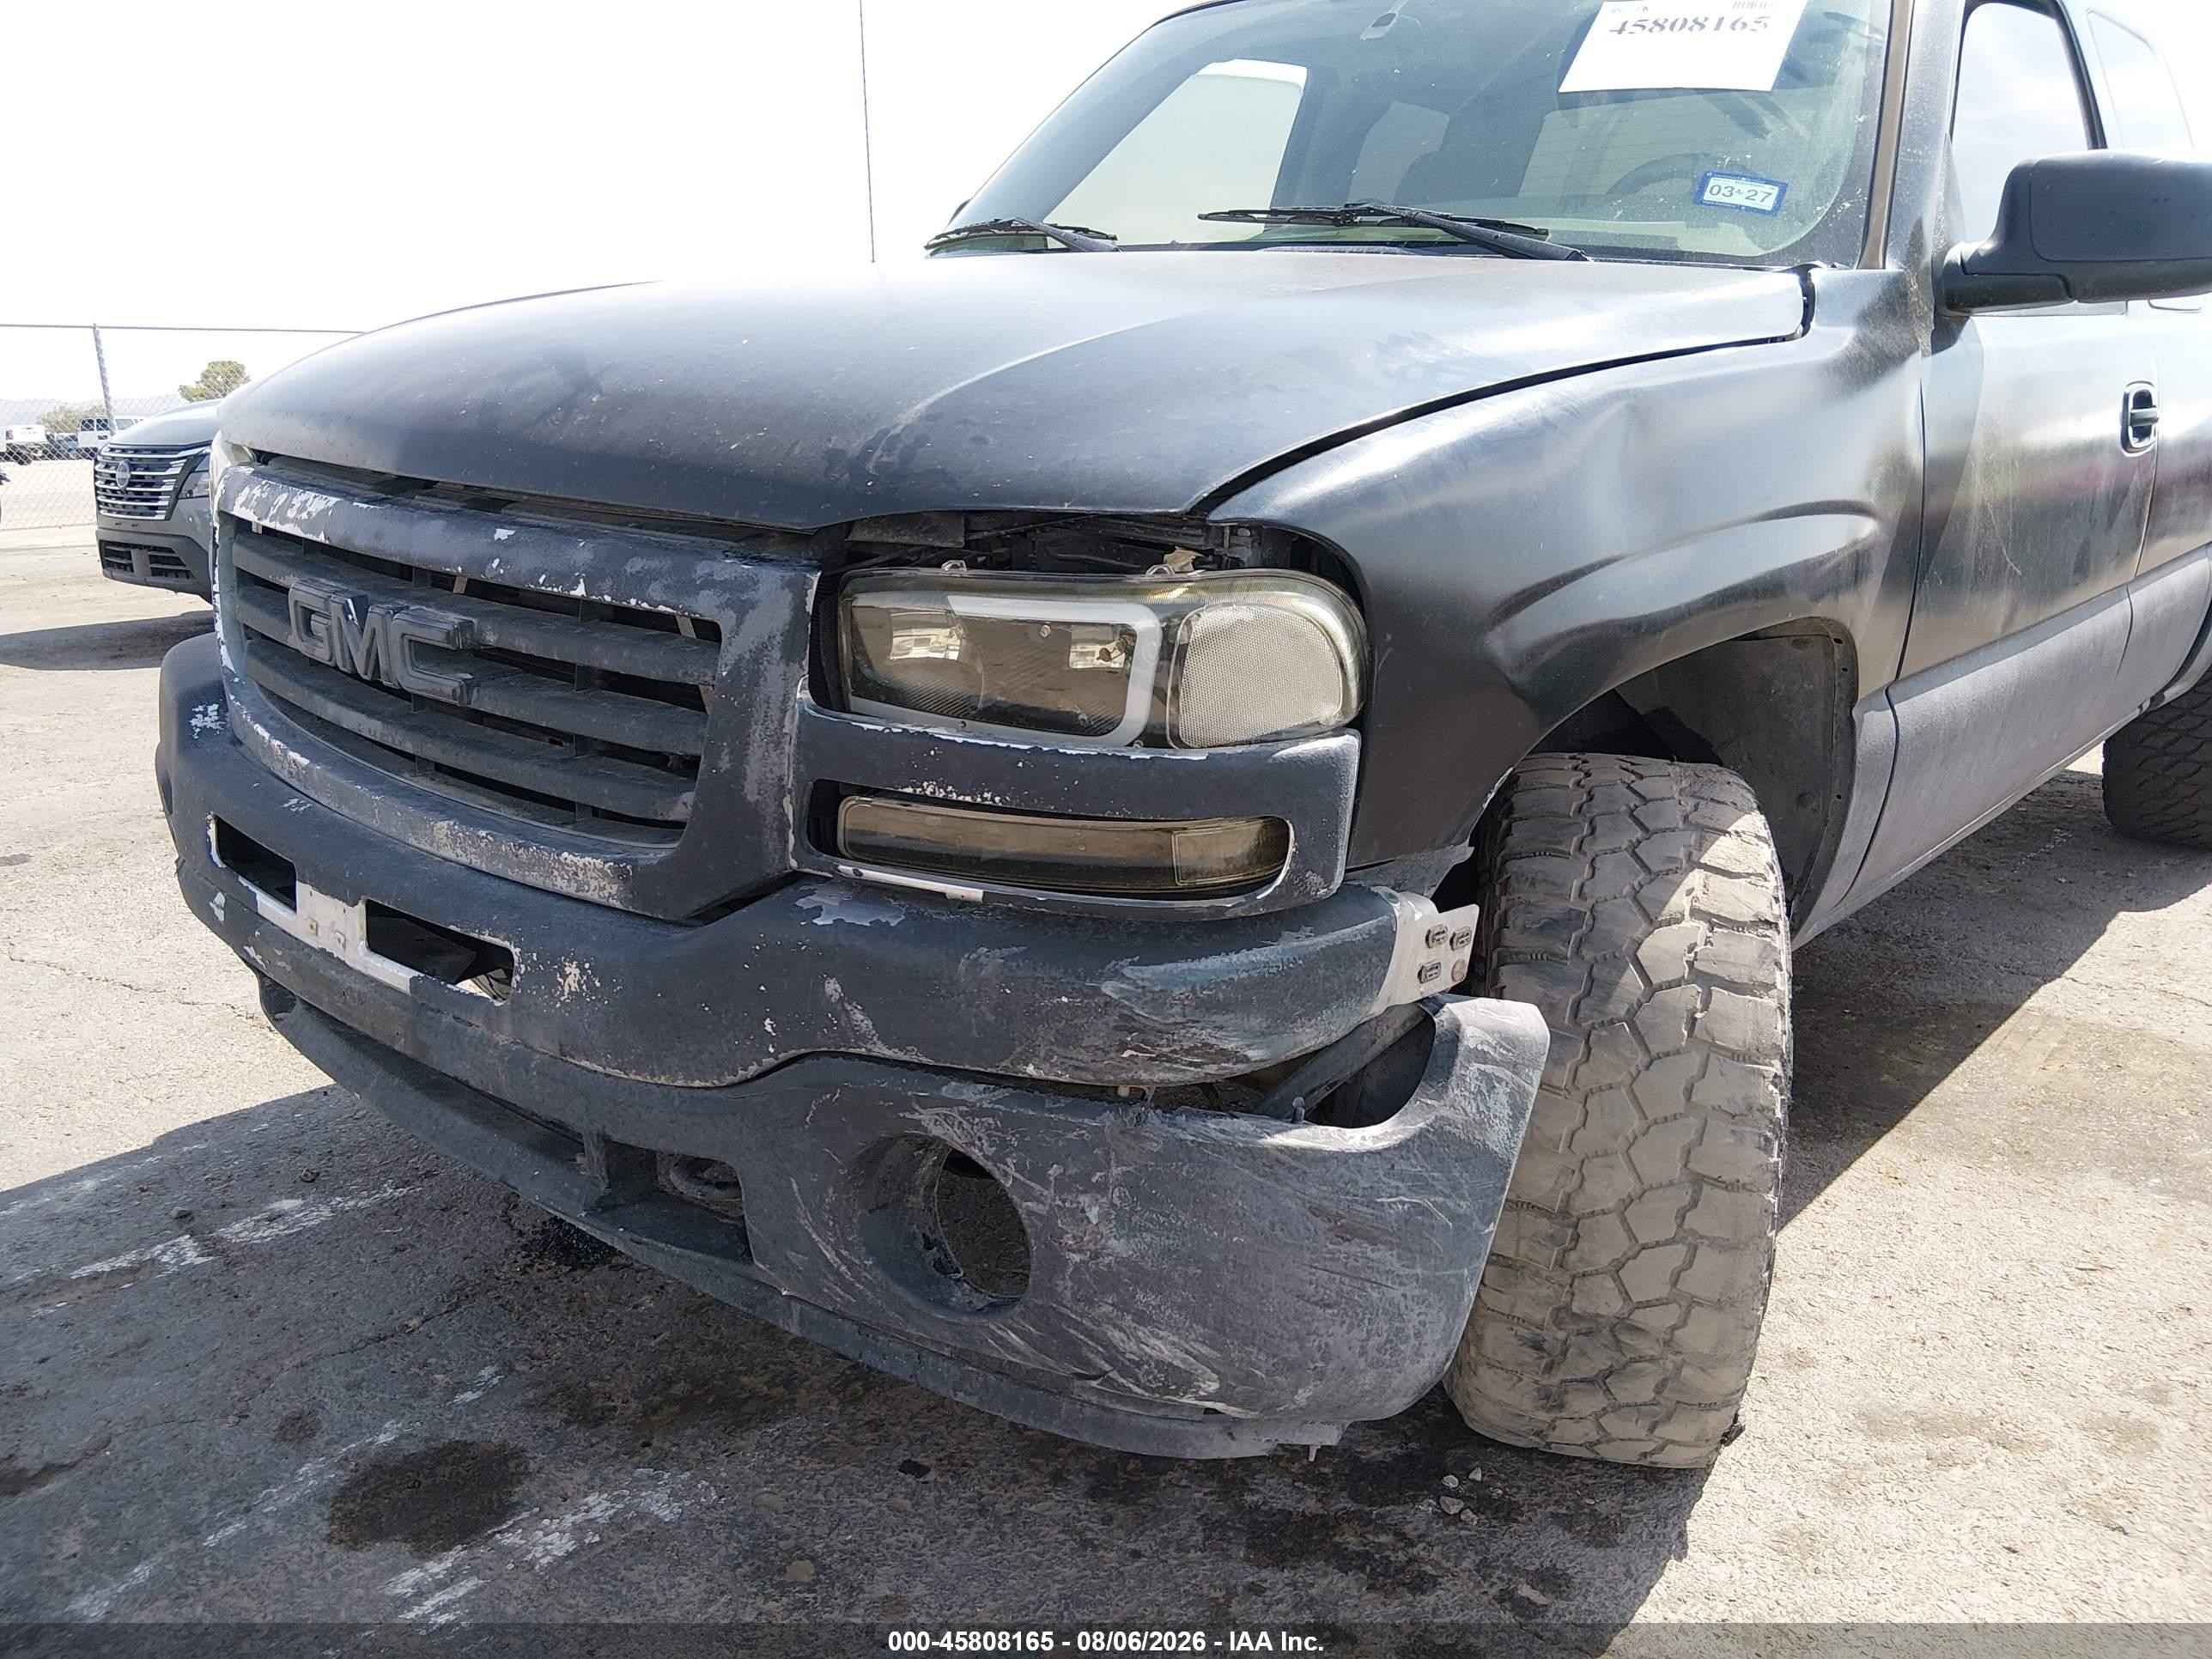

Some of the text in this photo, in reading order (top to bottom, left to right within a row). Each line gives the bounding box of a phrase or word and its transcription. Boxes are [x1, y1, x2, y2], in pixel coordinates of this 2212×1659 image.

[1609, 15, 1771, 35] 45808165
[1709, 184, 1735, 198] 03
[1744, 189, 1773, 203] 27
[287, 578, 473, 706] GMC
